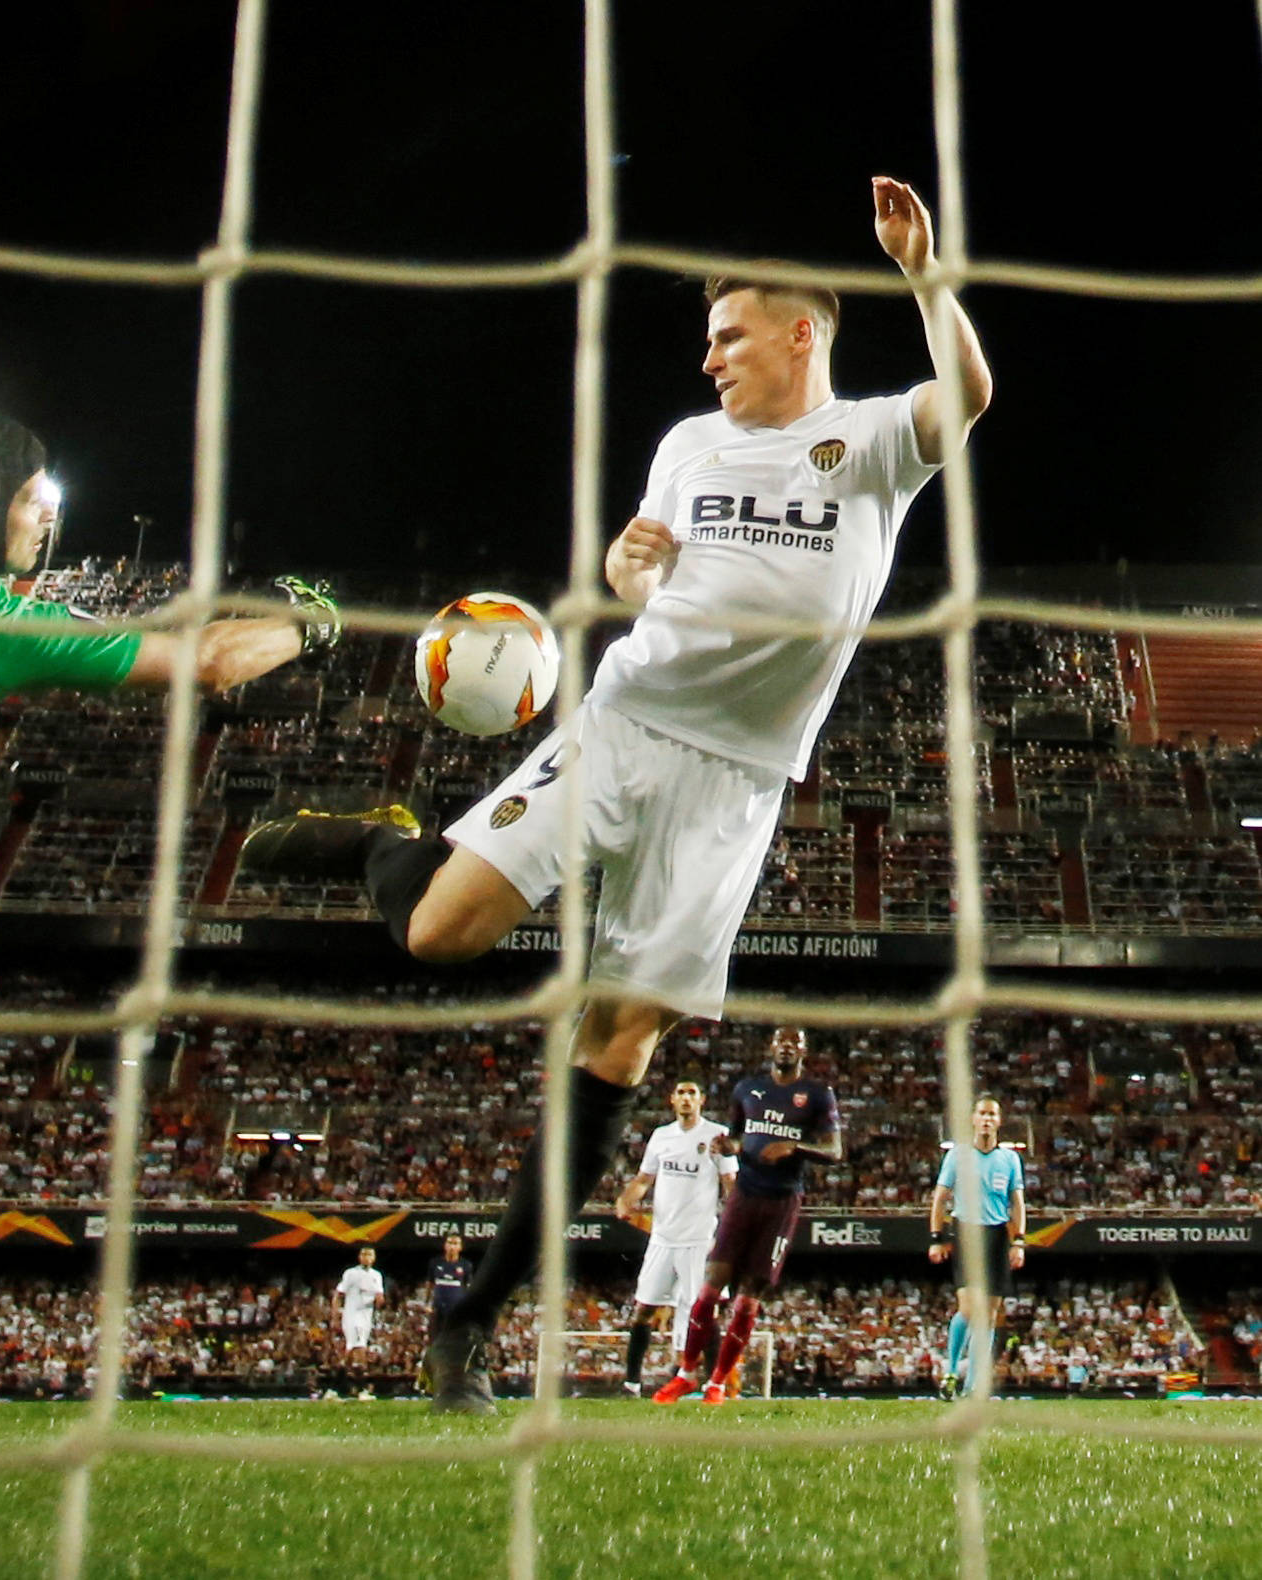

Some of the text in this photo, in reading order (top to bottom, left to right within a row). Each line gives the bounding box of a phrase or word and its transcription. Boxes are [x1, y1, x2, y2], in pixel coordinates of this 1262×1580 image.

[691, 495, 840, 532] BLU
[496, 930, 562, 951] MESTAL
[802, 934, 878, 957] AFICIÓN!
[663, 1161, 699, 1173] BLU
[414, 1221, 602, 1240] UEFA EUR GUE
[811, 1222, 883, 1246] FedEx
[1097, 1227, 1252, 1242] TOGETHER TO BAKU
